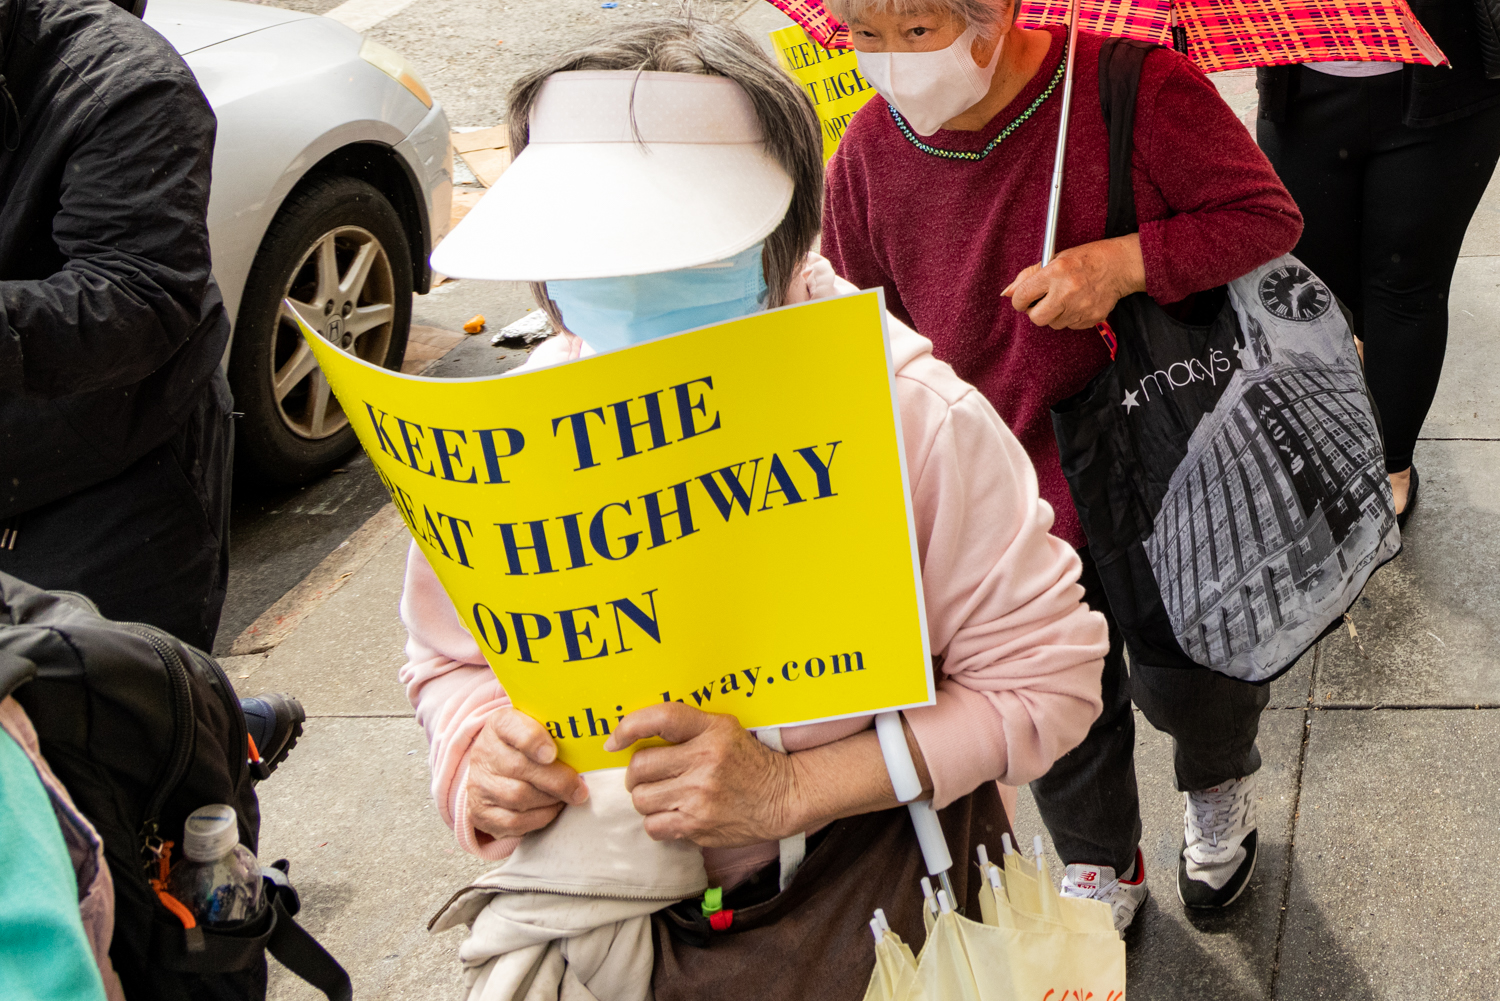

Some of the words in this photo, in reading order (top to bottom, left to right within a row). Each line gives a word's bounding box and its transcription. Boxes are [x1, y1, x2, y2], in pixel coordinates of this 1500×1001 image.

[822, 68, 874, 103] HIGH
[825, 110, 858, 142] OPE
[1139, 347, 1231, 402] macy's
[361, 399, 526, 486] KEEP
[551, 376, 722, 473] THE
[374, 463, 475, 571] EAT
[493, 440, 844, 577] HIGHWAY
[472, 588, 663, 665] OPEN
